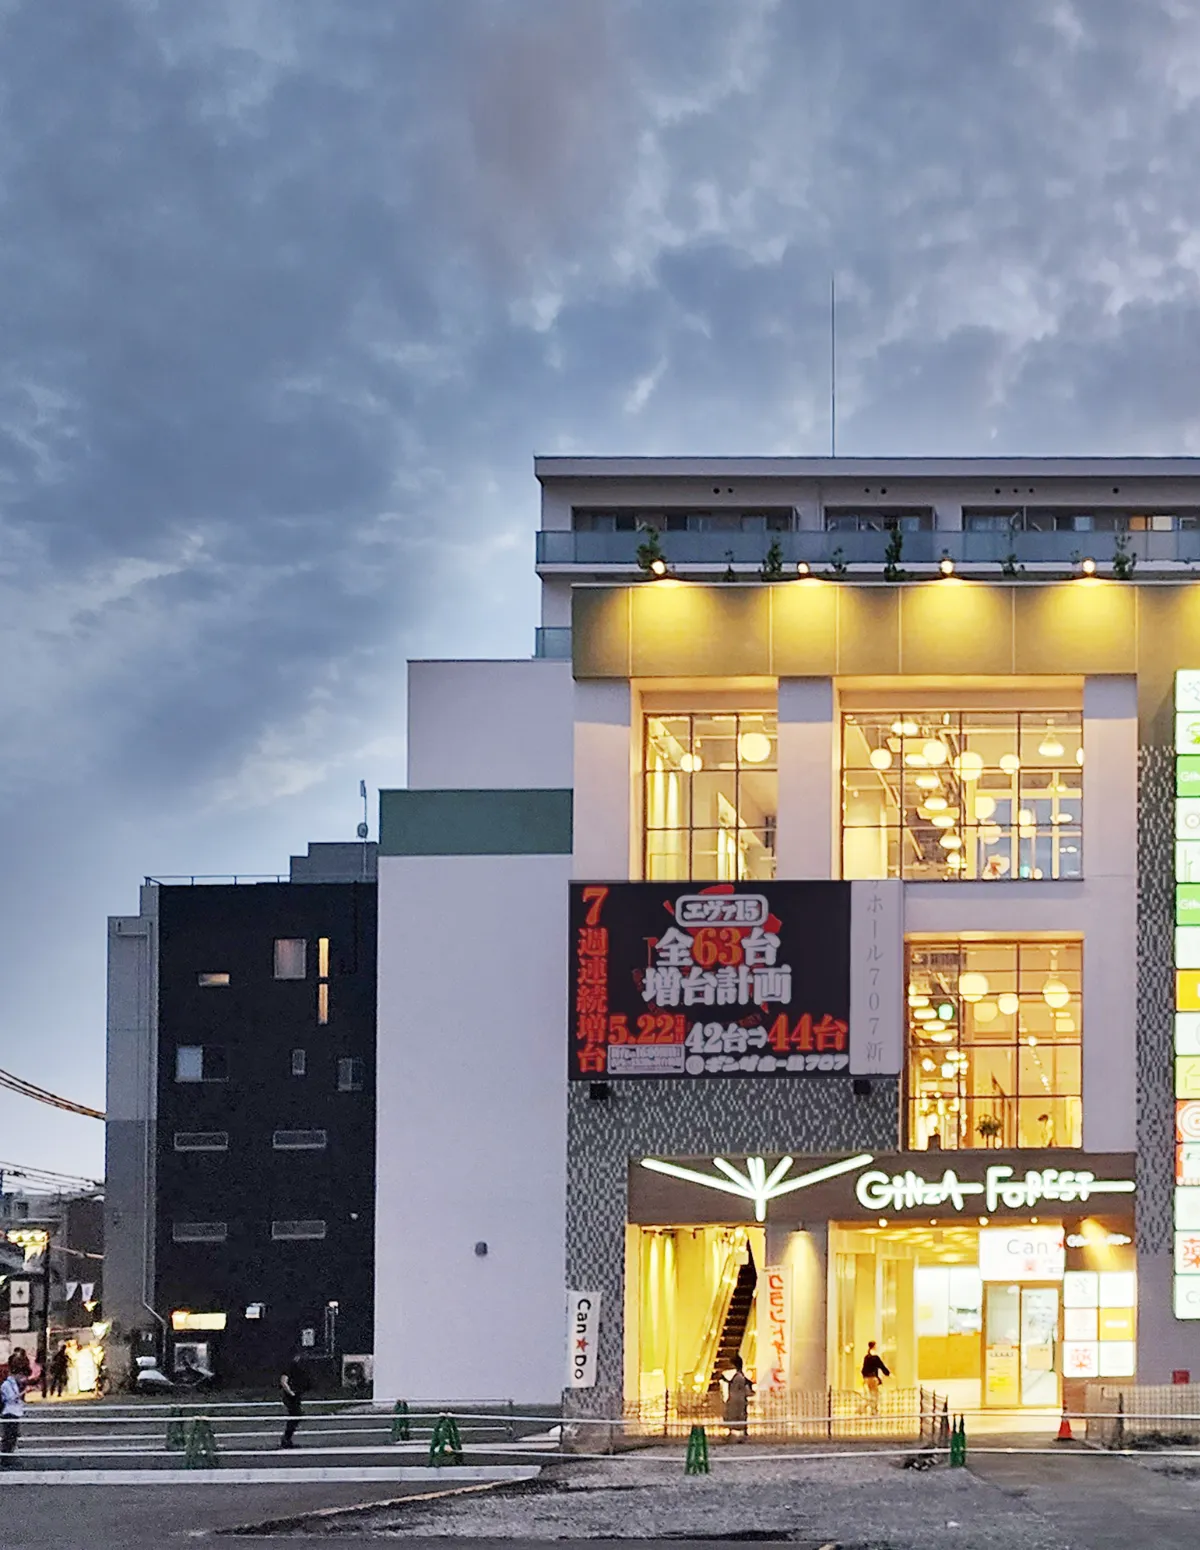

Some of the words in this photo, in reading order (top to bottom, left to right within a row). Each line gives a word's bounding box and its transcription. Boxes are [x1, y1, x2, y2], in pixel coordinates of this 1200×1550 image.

[683, 900, 760, 922] エヴァ15
[655, 926, 782, 967] 全63台
[576, 886, 609, 1074] 7週連続増台
[641, 964, 792, 1007] 増台計画
[866, 880, 884, 1074] ホール707新
[608, 1014, 674, 1045] 5.22
[768, 1012, 849, 1052] 44台
[1006, 1239, 1049, 1255] Can
[576, 1298, 592, 1334] Can
[574, 1355, 587, 1380] Do
